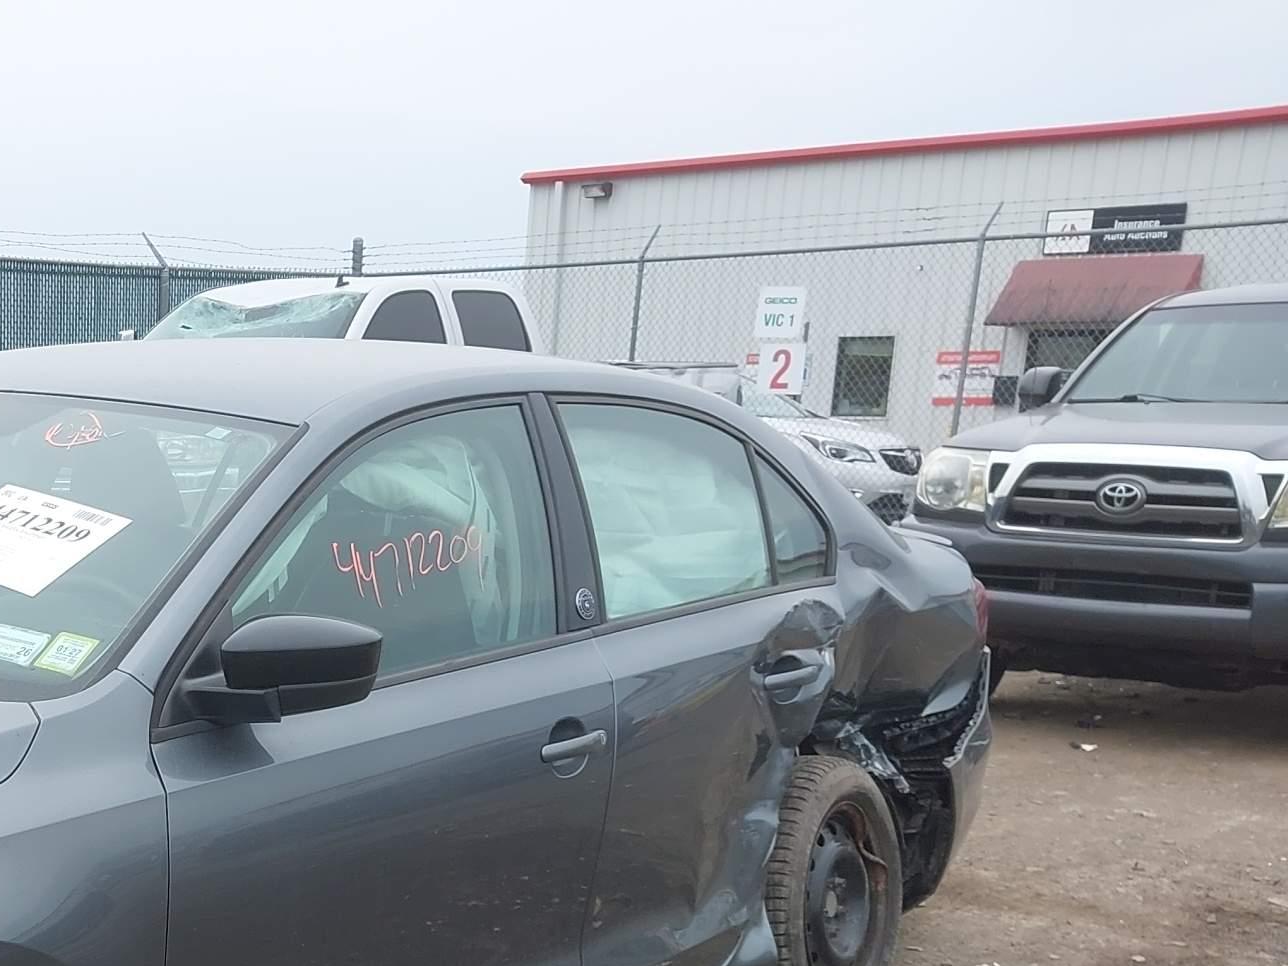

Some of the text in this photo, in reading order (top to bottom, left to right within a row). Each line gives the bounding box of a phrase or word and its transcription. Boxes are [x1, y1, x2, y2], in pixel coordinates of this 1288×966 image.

[1114, 219, 1161, 231] Insurance
[763, 296, 798, 305] GEICO
[763, 313, 785, 328] VIC
[769, 348, 792, 390] 2
[331, 525, 485, 609] 44712209
